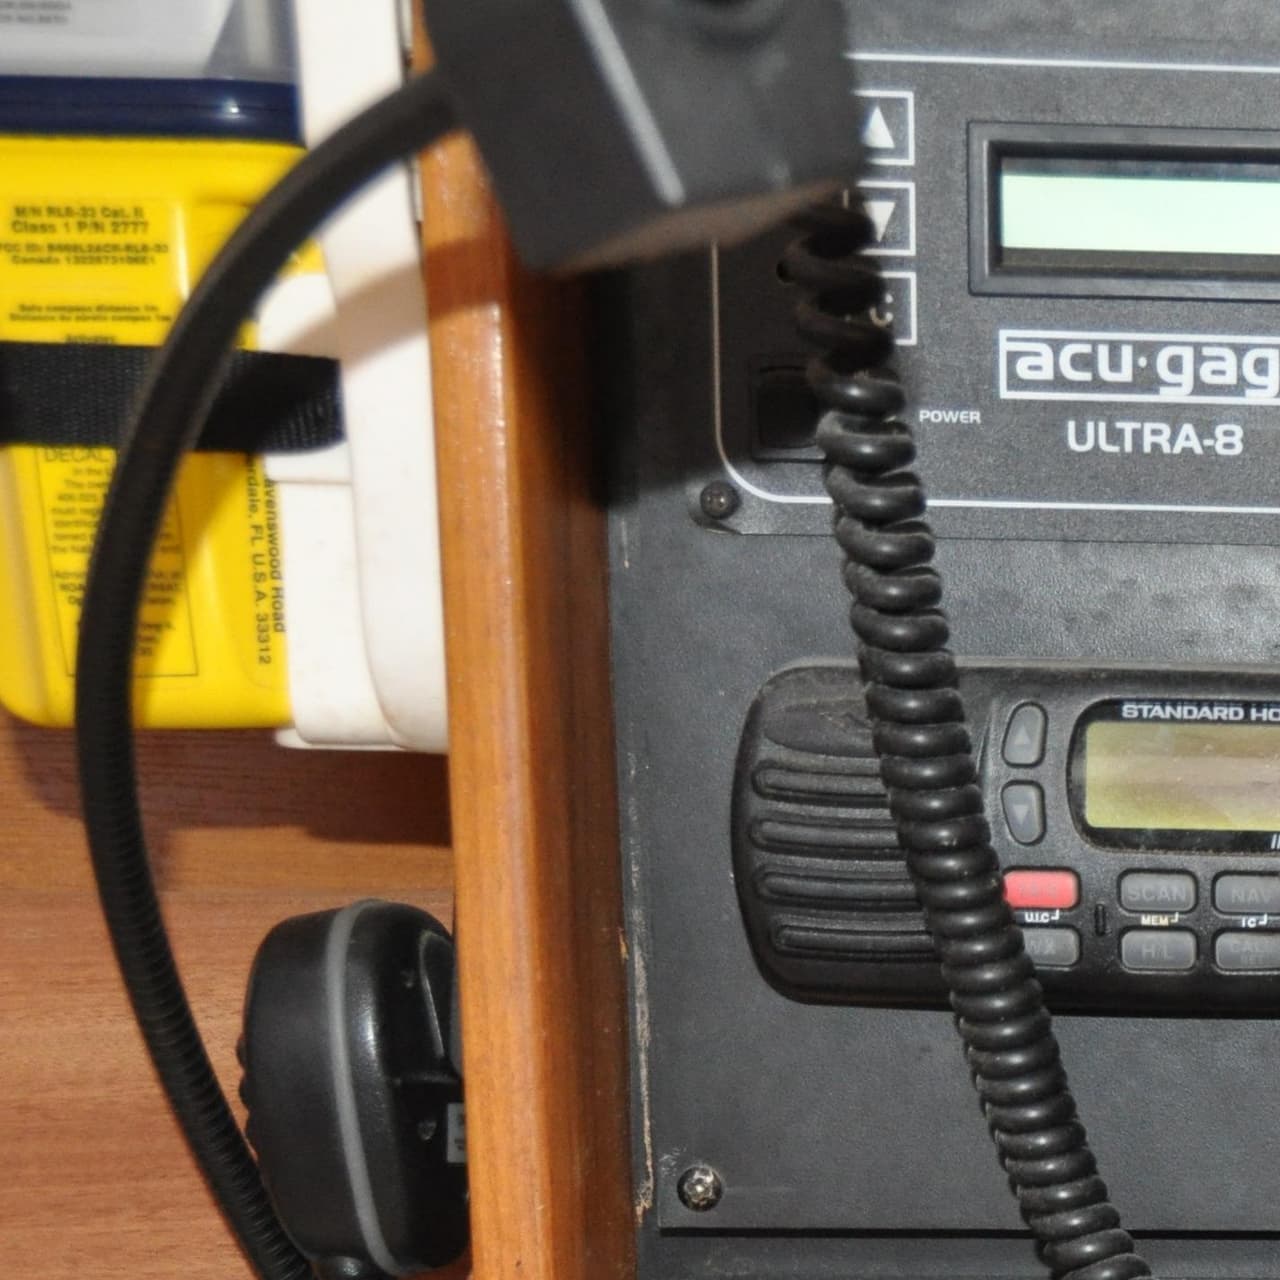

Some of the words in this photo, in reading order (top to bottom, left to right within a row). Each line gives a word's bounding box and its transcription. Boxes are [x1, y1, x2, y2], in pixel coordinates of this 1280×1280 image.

[918, 409, 982, 424] POWER
[1067, 420, 1244, 456] ULTRA-8
[1121, 703, 1245, 721] STANDARD
